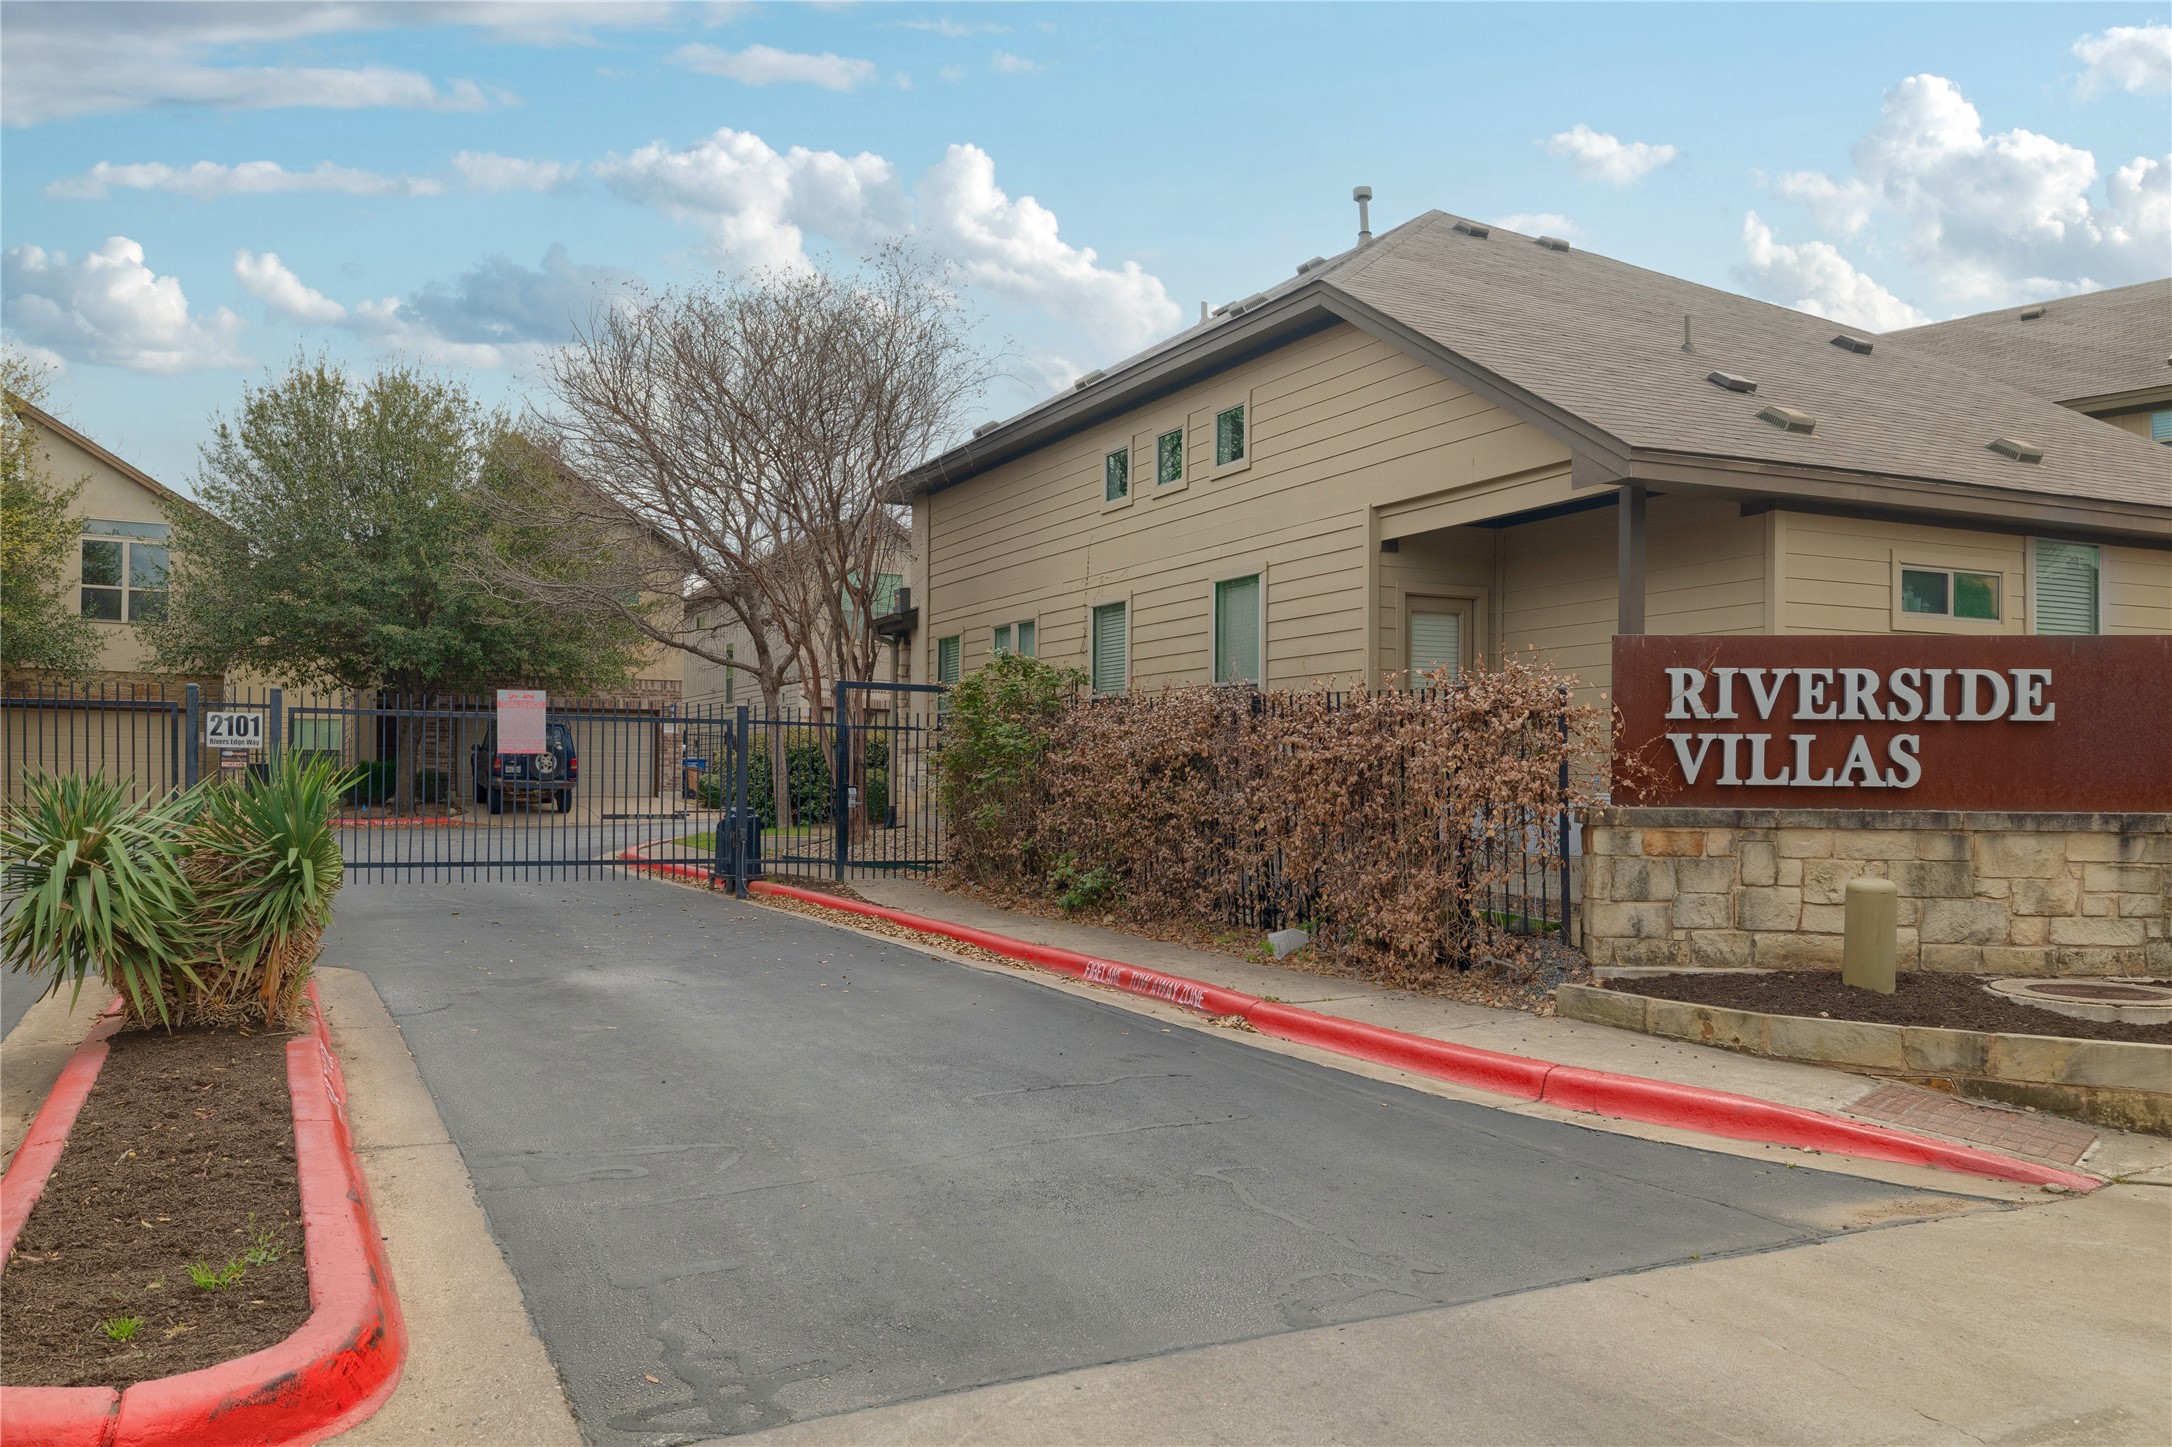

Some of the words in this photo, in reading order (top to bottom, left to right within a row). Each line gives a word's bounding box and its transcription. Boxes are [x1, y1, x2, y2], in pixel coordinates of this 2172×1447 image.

[1664, 667, 2056, 722] RIVERSIDE
[209, 714, 260, 738] 2101
[209, 738, 229, 746] Rivers
[230, 738, 245, 746] Edge
[246, 739, 260, 747] Way
[1665, 733, 1922, 788] VILLAS
[1129, 971, 1153, 994] TOW
[1149, 976, 1181, 1001] AWAY
[1178, 984, 1209, 1009] ZONE
